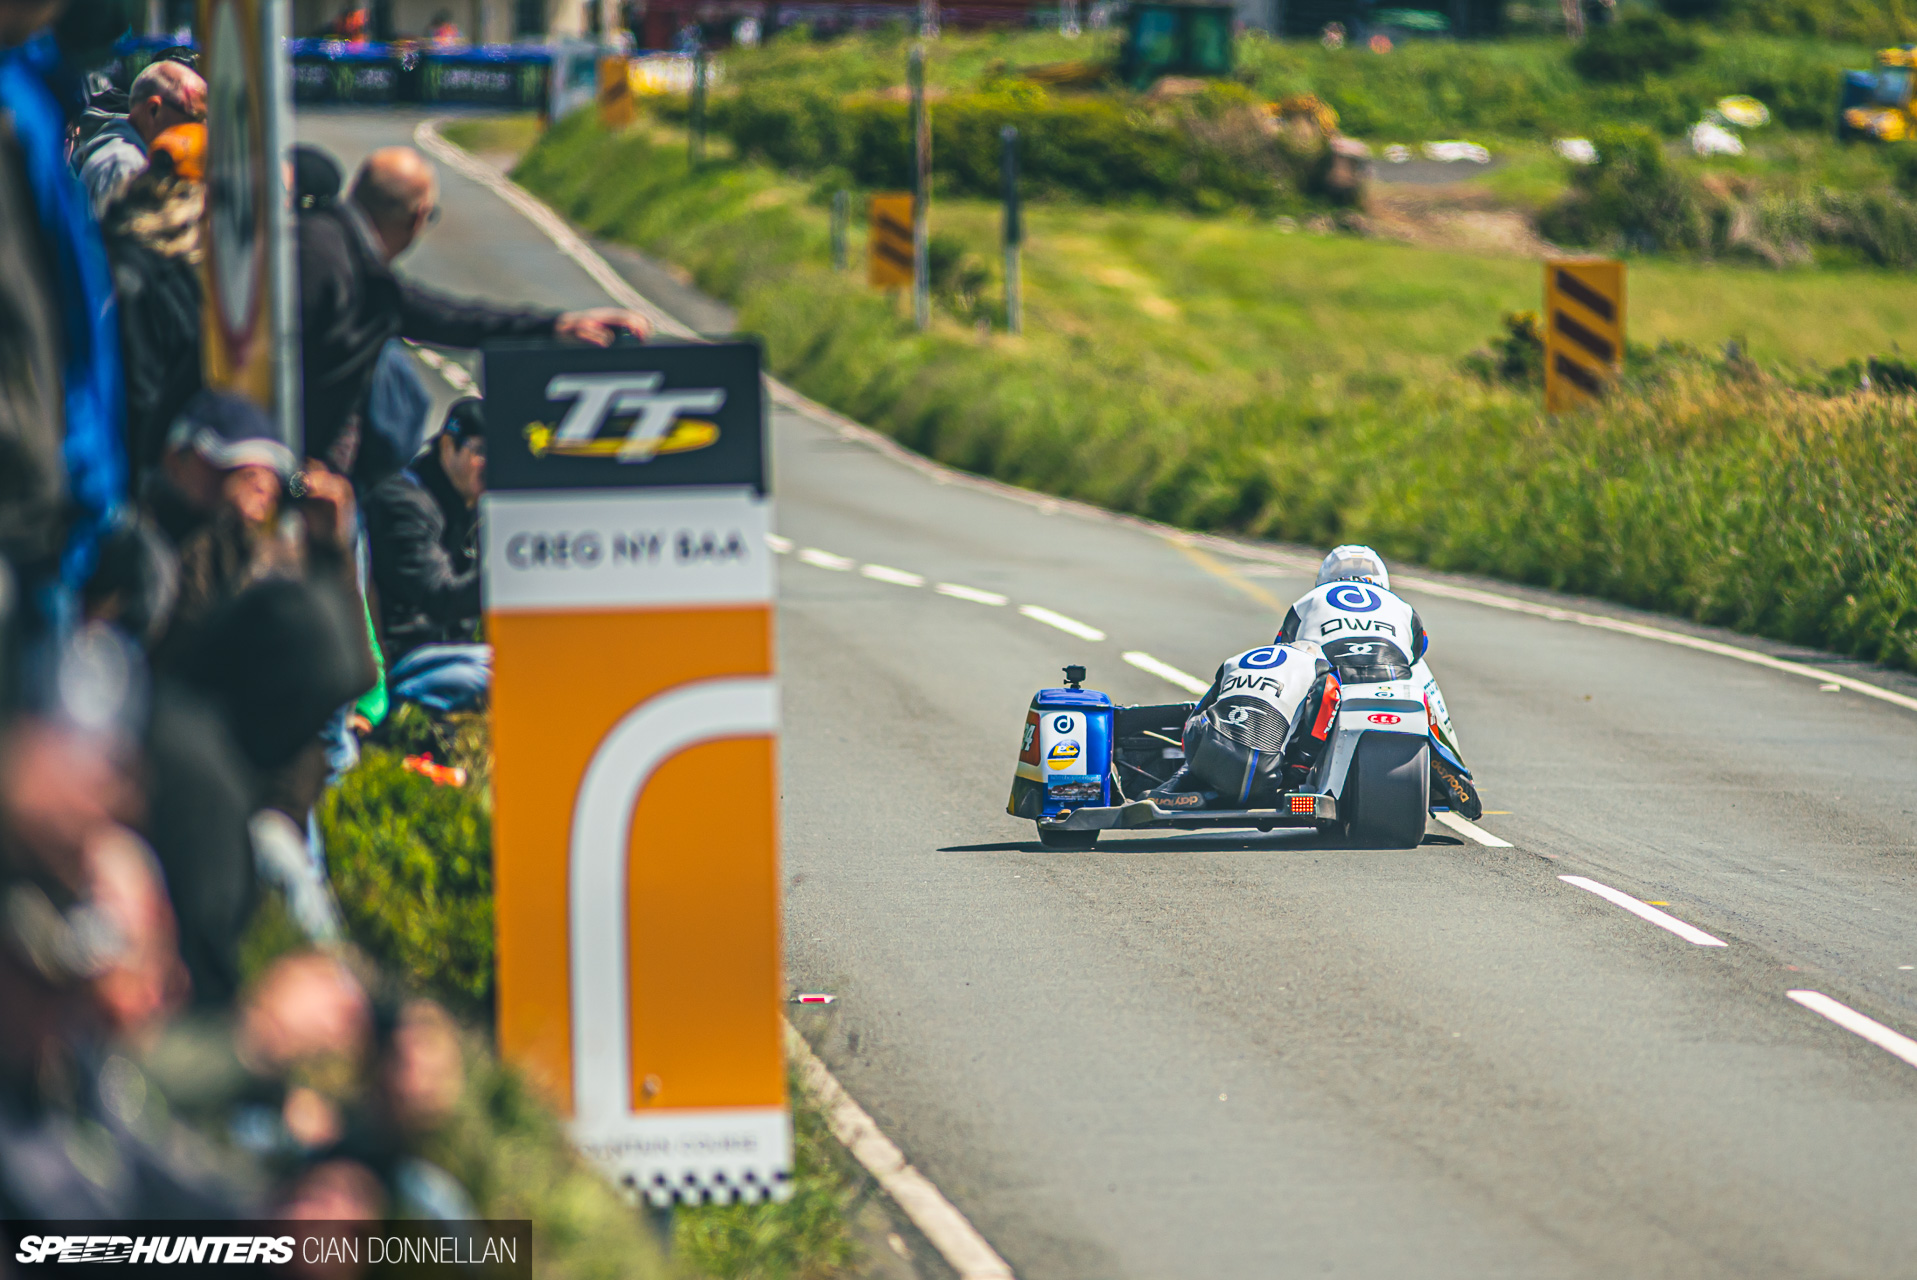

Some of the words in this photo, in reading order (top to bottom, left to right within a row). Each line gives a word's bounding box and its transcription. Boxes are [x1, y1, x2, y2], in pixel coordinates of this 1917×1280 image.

[545, 373, 726, 465] TT
[506, 531, 604, 571] CREG
[612, 528, 664, 567] NY
[674, 525, 747, 566] BAA
